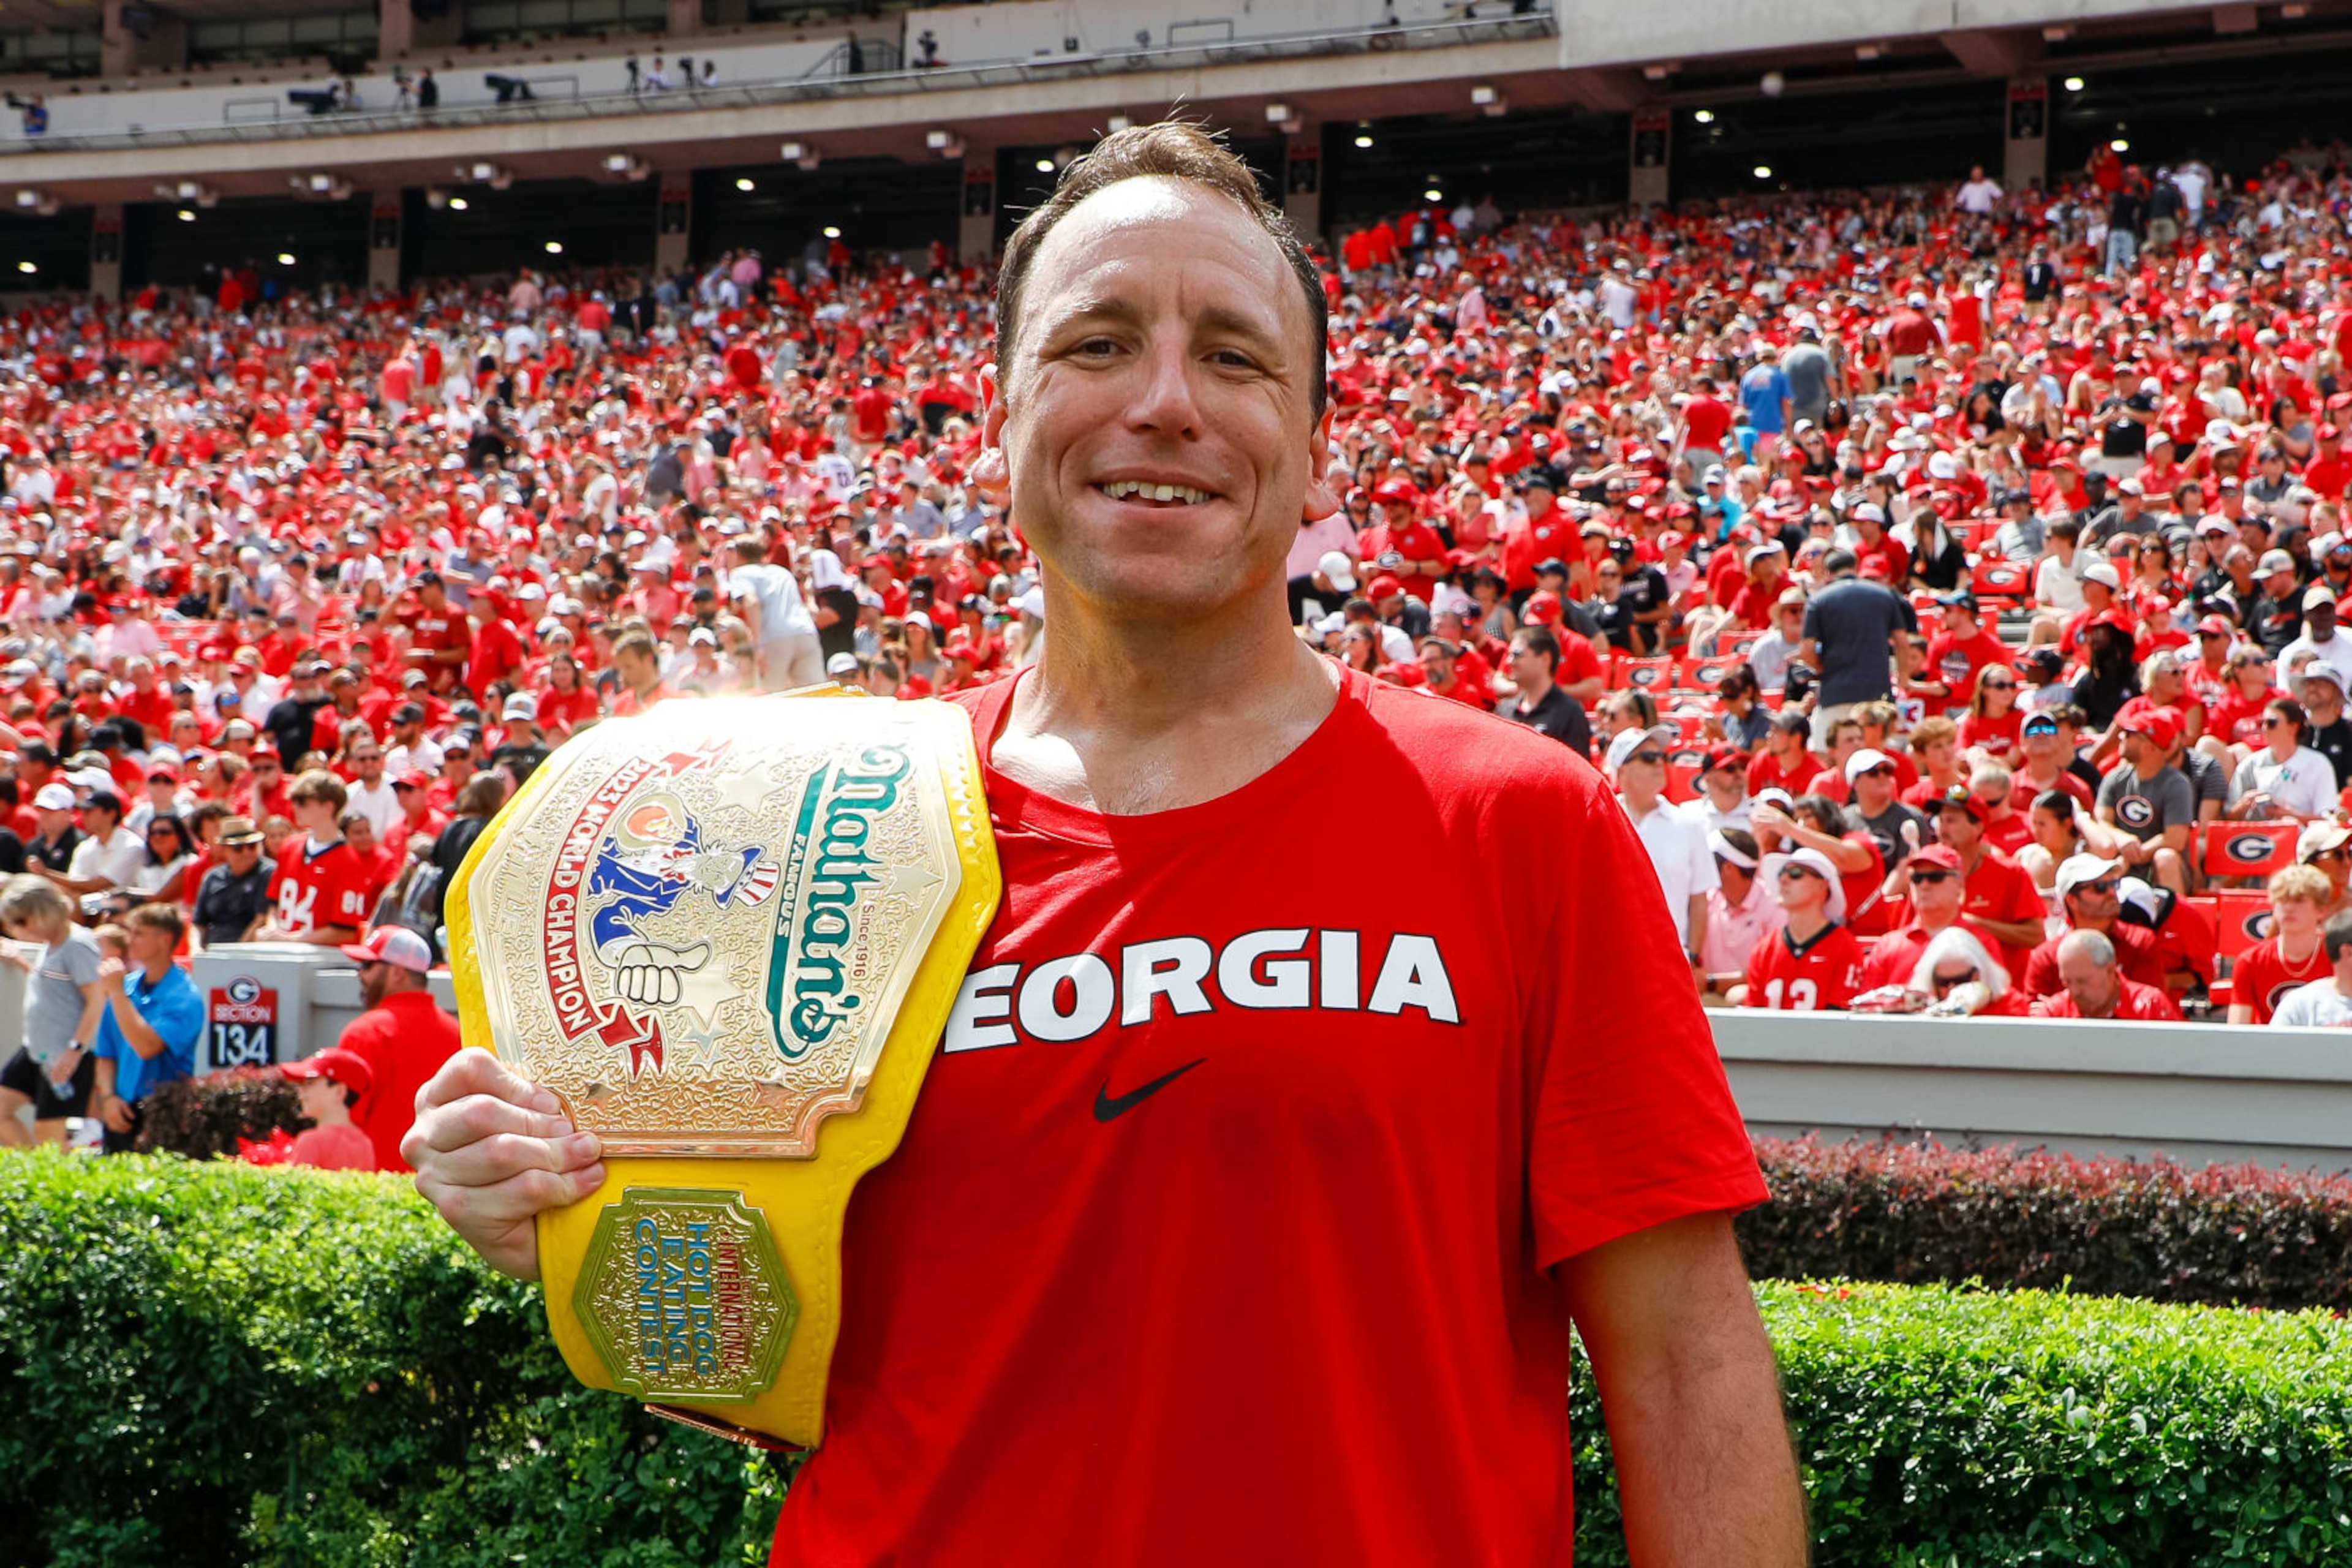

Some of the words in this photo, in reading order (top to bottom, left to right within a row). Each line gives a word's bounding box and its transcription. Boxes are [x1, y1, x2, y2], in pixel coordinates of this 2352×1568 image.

[597, 759, 653, 804] 2023
[554, 804, 610, 888] WORLD
[777, 832, 807, 938] FAMOUS
[276, 877, 318, 934] 84
[790, 743, 910, 1043] Nathan's
[857, 905, 875, 941] Since
[548, 893, 592, 1032] CHAMPION
[853, 946, 868, 977] 1916
[942, 927, 1464, 1054] EORGIA
[214, 1005, 271, 1022] SECTION
[215, 1024, 269, 1066] 134
[635, 1219, 666, 1376] CONTEST
[688, 1223, 711, 1297] HOT
[662, 1238, 690, 1363] EATING
[719, 1242, 745, 1367] INTERNATIONAL
[692, 1308, 717, 1376] DOG
